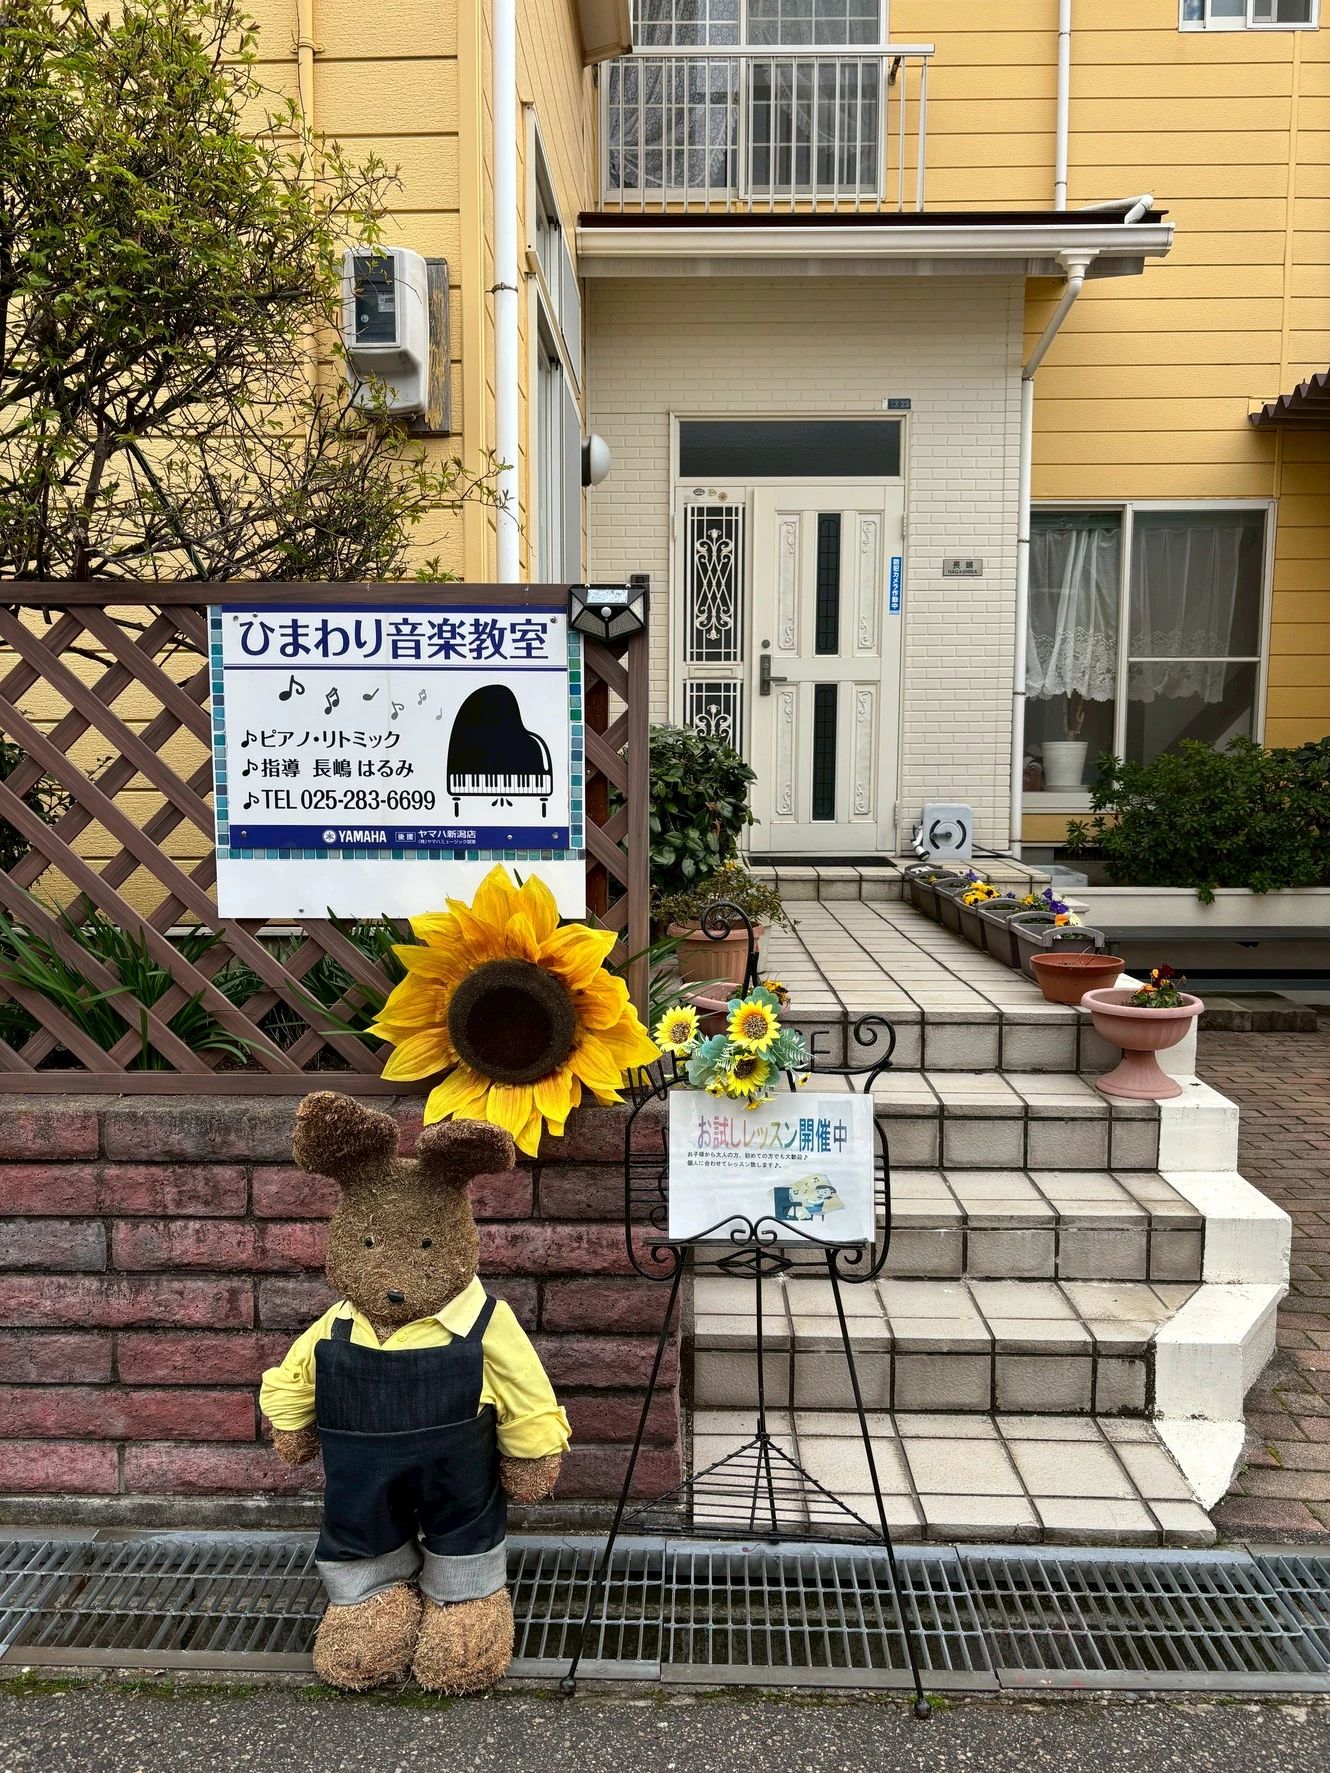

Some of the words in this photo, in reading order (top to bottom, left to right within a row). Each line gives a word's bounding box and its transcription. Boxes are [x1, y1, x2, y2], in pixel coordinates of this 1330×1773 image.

[891, 558, 900, 610] 防犯カメラ作動中
[239, 617, 549, 660] ひまわり音楽教室
[260, 729, 401, 749] ピアノ・リトミック
[261, 758, 301, 778] 指導
[312, 758, 352, 778] 長嶋
[358, 759, 415, 778] はるみ
[261, 789, 298, 810] TEL
[301, 789, 436, 810] 025-283-6699
[338, 830, 387, 843] YAMAHA
[418, 829, 477, 839] ヤマハ新潟店
[697, 1115, 848, 1153] お試しレッスン開催中
